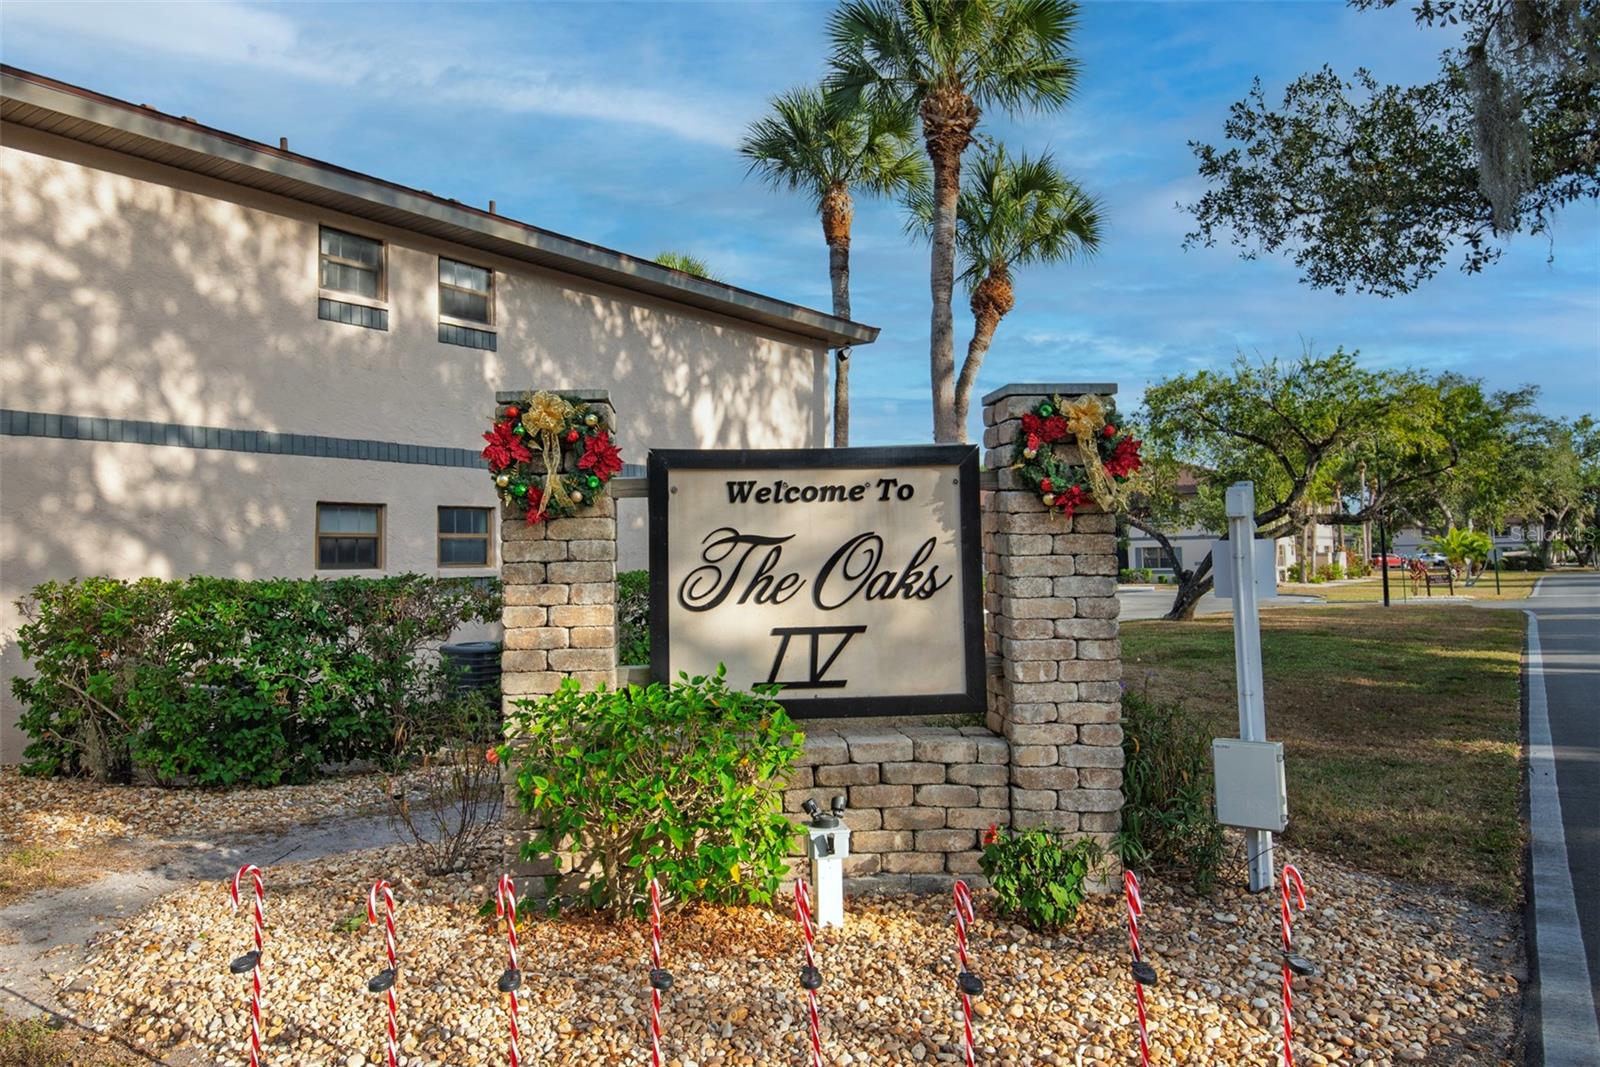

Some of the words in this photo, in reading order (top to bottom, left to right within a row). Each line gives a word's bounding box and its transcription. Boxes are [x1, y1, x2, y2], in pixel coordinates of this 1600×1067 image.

[725, 480, 866, 505] Welcome
[875, 478, 915, 502] To
[678, 527, 807, 612] The
[813, 531, 953, 611] Oaks
[751, 625, 868, 689] IV
